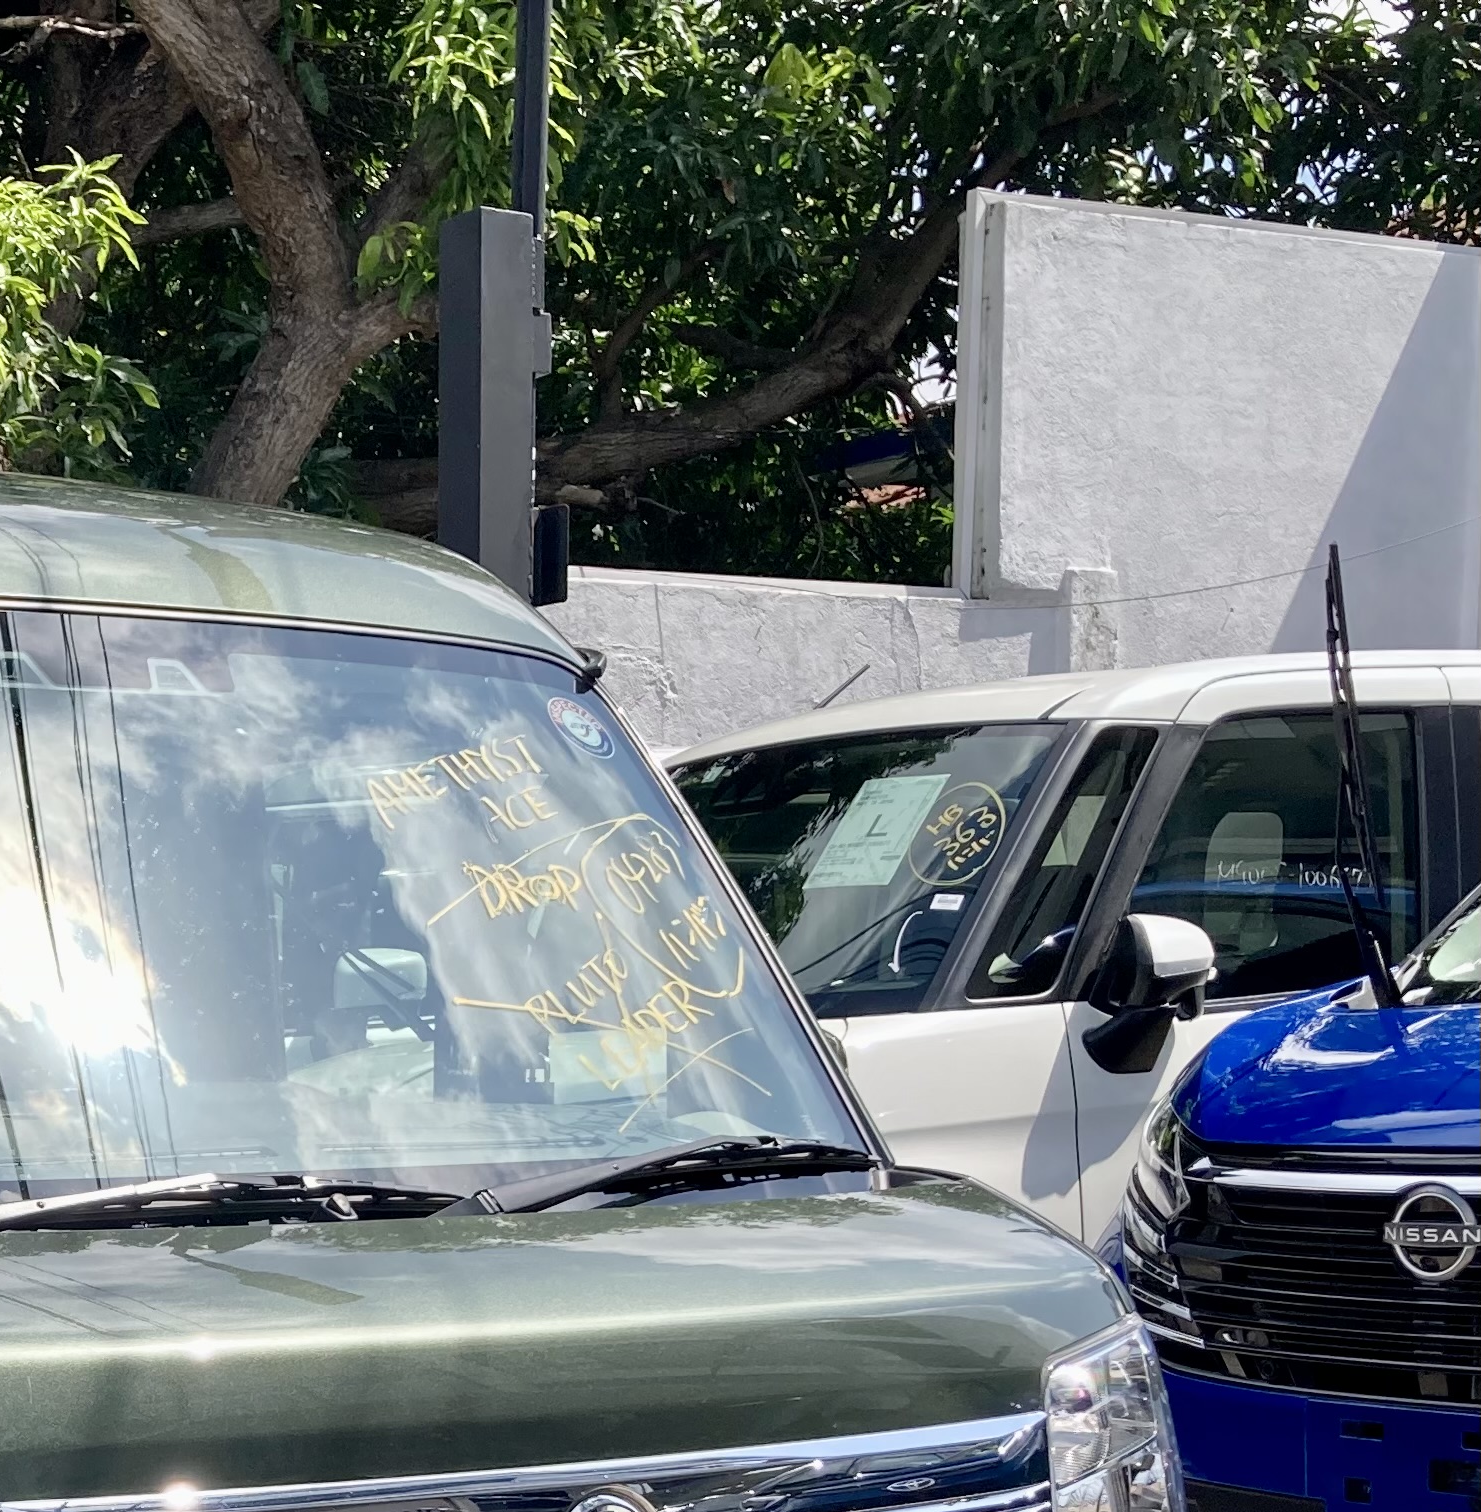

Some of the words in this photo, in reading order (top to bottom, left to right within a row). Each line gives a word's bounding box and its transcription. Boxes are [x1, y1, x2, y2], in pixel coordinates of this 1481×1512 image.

[367, 734, 543, 830] AMETHYST
[479, 785, 559, 831] ACE
[933, 806, 997, 857] 363
[1384, 1226, 1481, 1244] NISSAN
